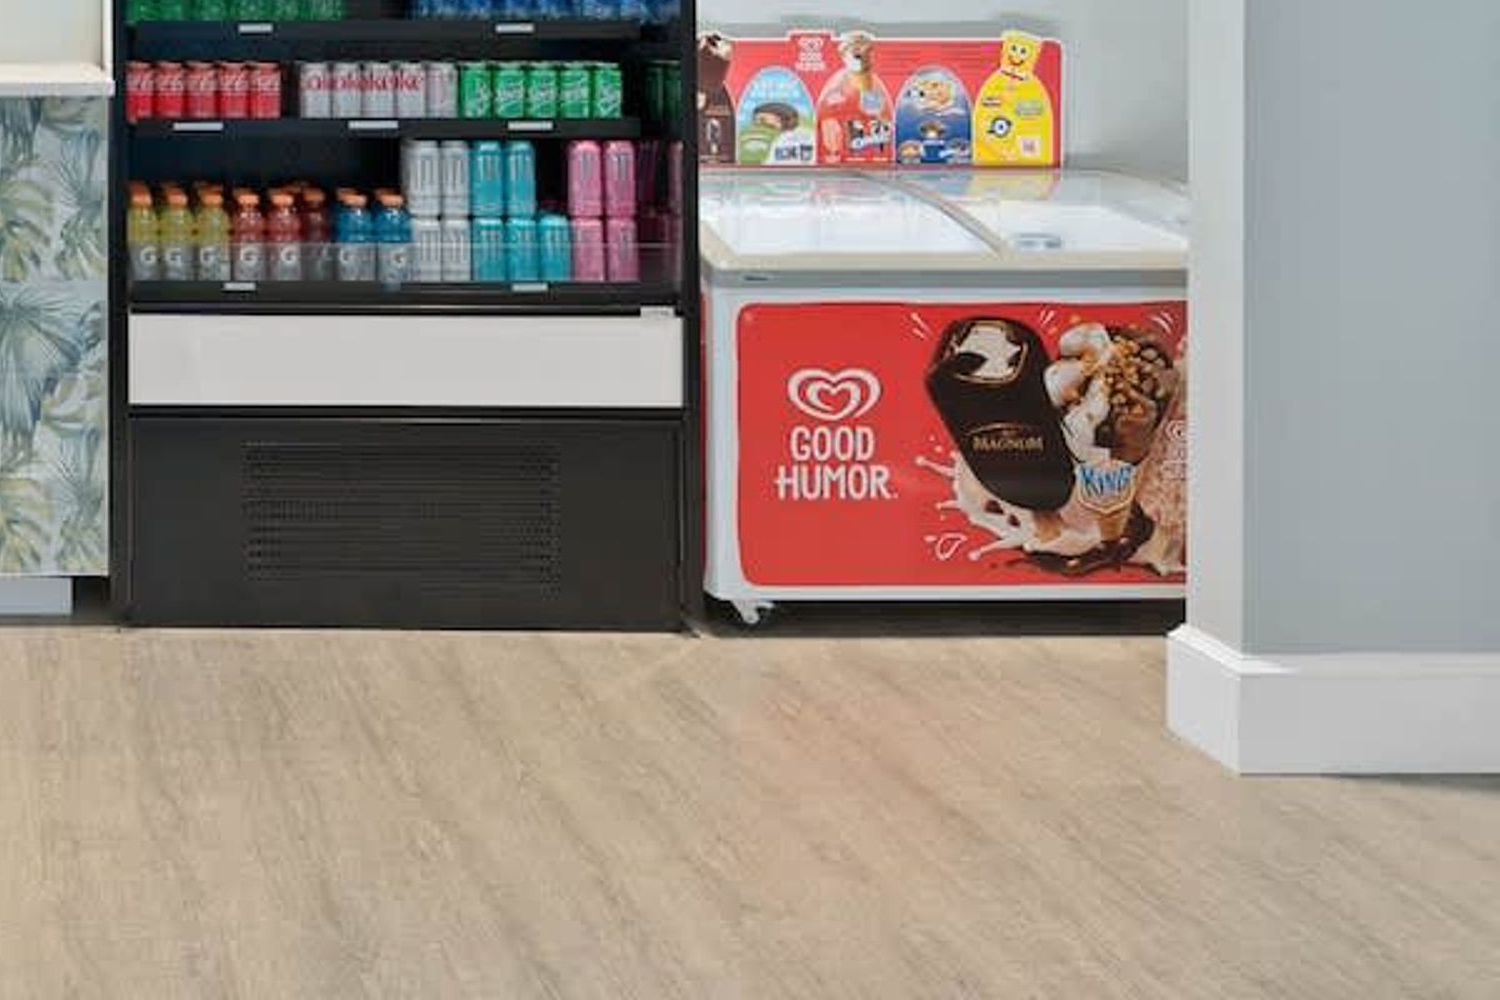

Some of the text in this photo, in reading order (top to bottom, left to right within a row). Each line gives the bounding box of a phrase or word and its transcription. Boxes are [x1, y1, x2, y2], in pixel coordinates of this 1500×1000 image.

[239, 246, 260, 265] G
[280, 246, 298, 265] G
[789, 426, 875, 462] GOOD
[971, 435, 1045, 454] MAGNUM
